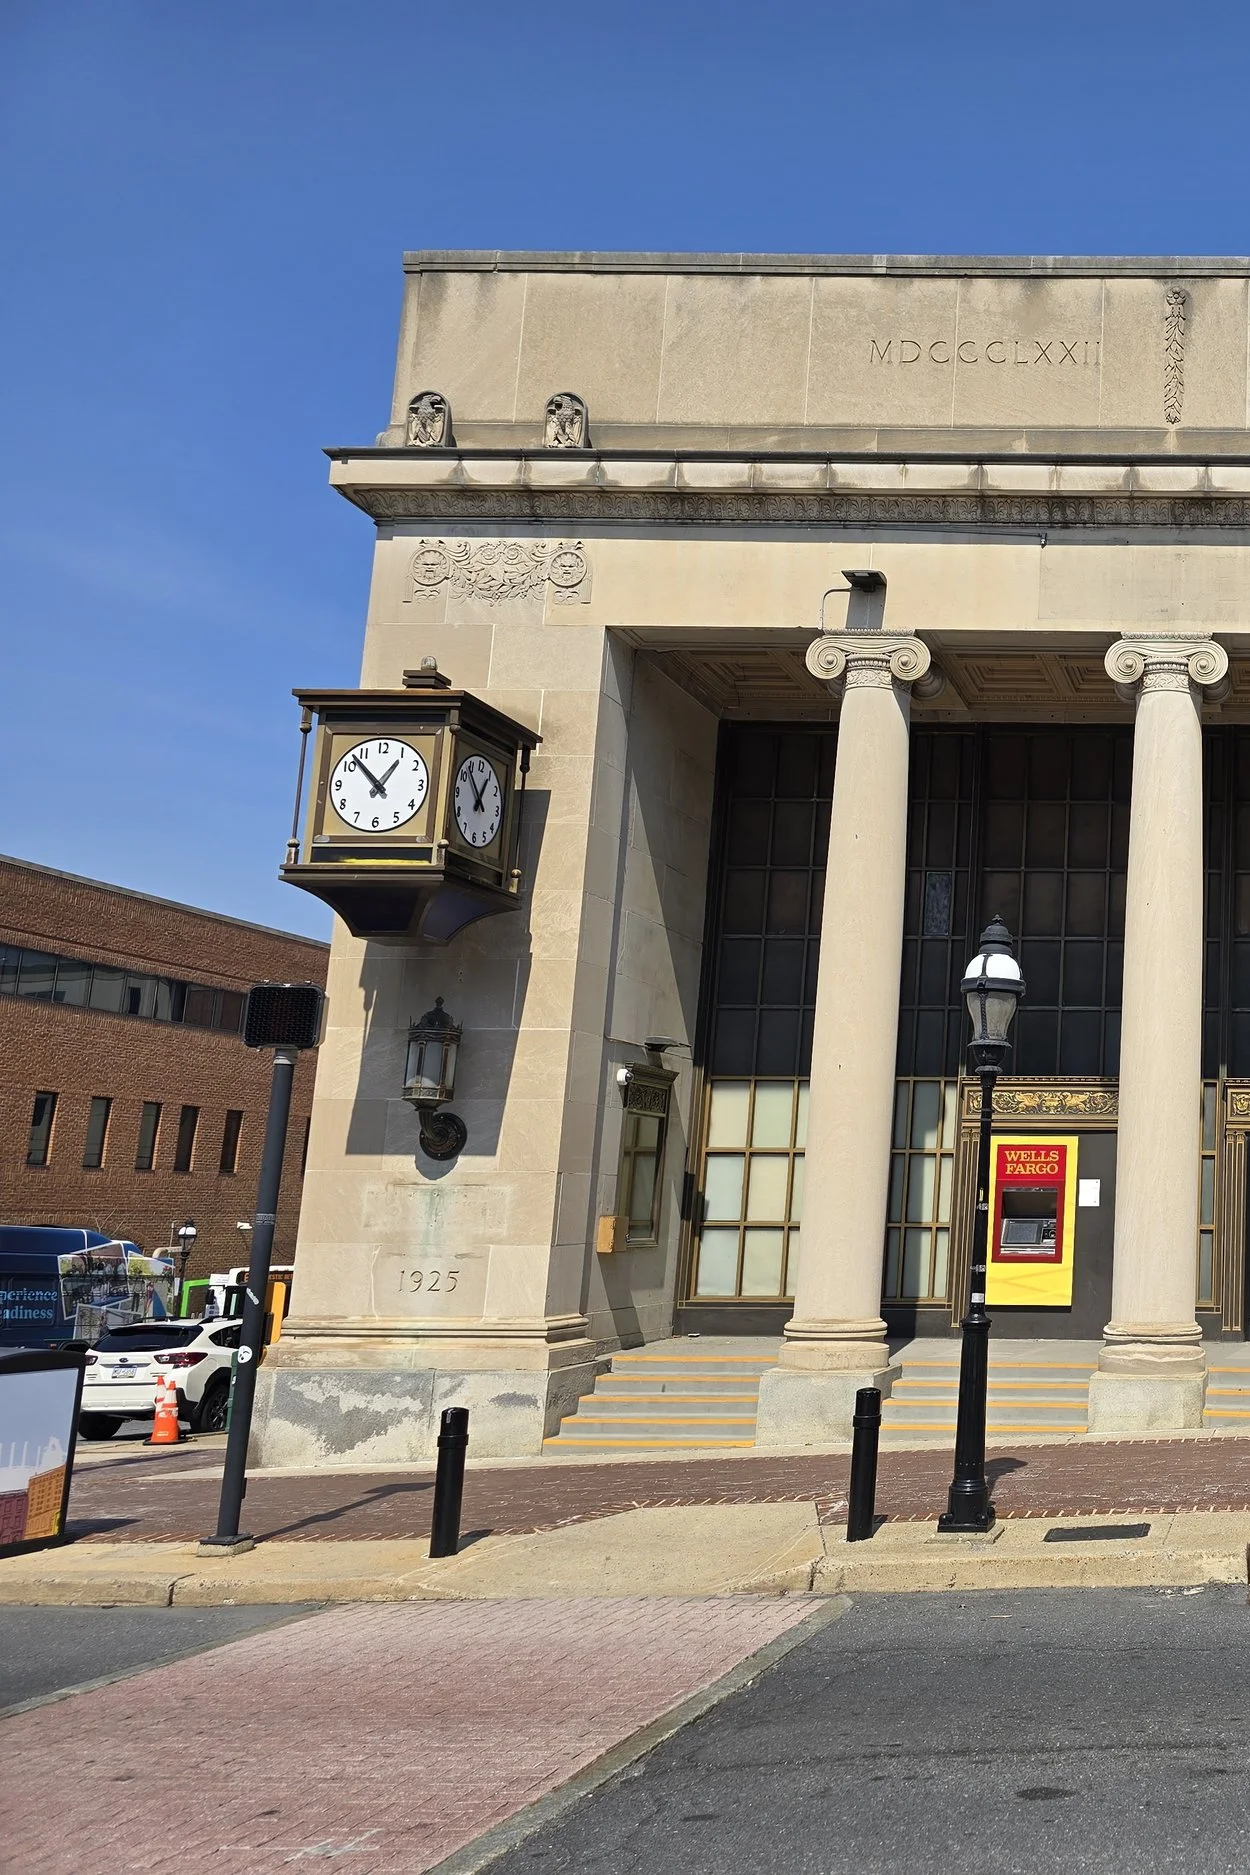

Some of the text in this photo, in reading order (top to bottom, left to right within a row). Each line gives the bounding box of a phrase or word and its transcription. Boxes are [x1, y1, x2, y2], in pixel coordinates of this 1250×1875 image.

[869, 339, 1100, 365] MDCCCLXXII
[360, 748, 369, 759] 11
[378, 742, 389, 754] 12
[401, 747, 404, 759] 1
[344, 760, 357, 772] 10
[412, 760, 419, 771] 2
[478, 760, 485, 773] 12
[460, 769, 468, 782] 10
[335, 780, 342, 791] 9
[417, 779, 424, 791] 3
[493, 785, 498, 797] 2
[455, 786, 460, 798] 9
[339, 798, 346, 810] 8
[407, 798, 415, 810] 4
[353, 811, 360, 823] 7
[456, 806, 461, 817] 8
[495, 805, 500, 817] 3
[371, 816, 379, 828] 6
[393, 811, 400, 824] 5
[463, 822, 467, 834] 7
[489, 822, 494, 834] 4
[471, 832, 476, 843] 6
[482, 831, 487, 843] 5
[1004, 1150, 1059, 1162] WELLS
[1005, 1163, 1059, 1175] FARGO
[399, 1270, 460, 1293] 1925
[0, 1305, 54, 1319] adiness
